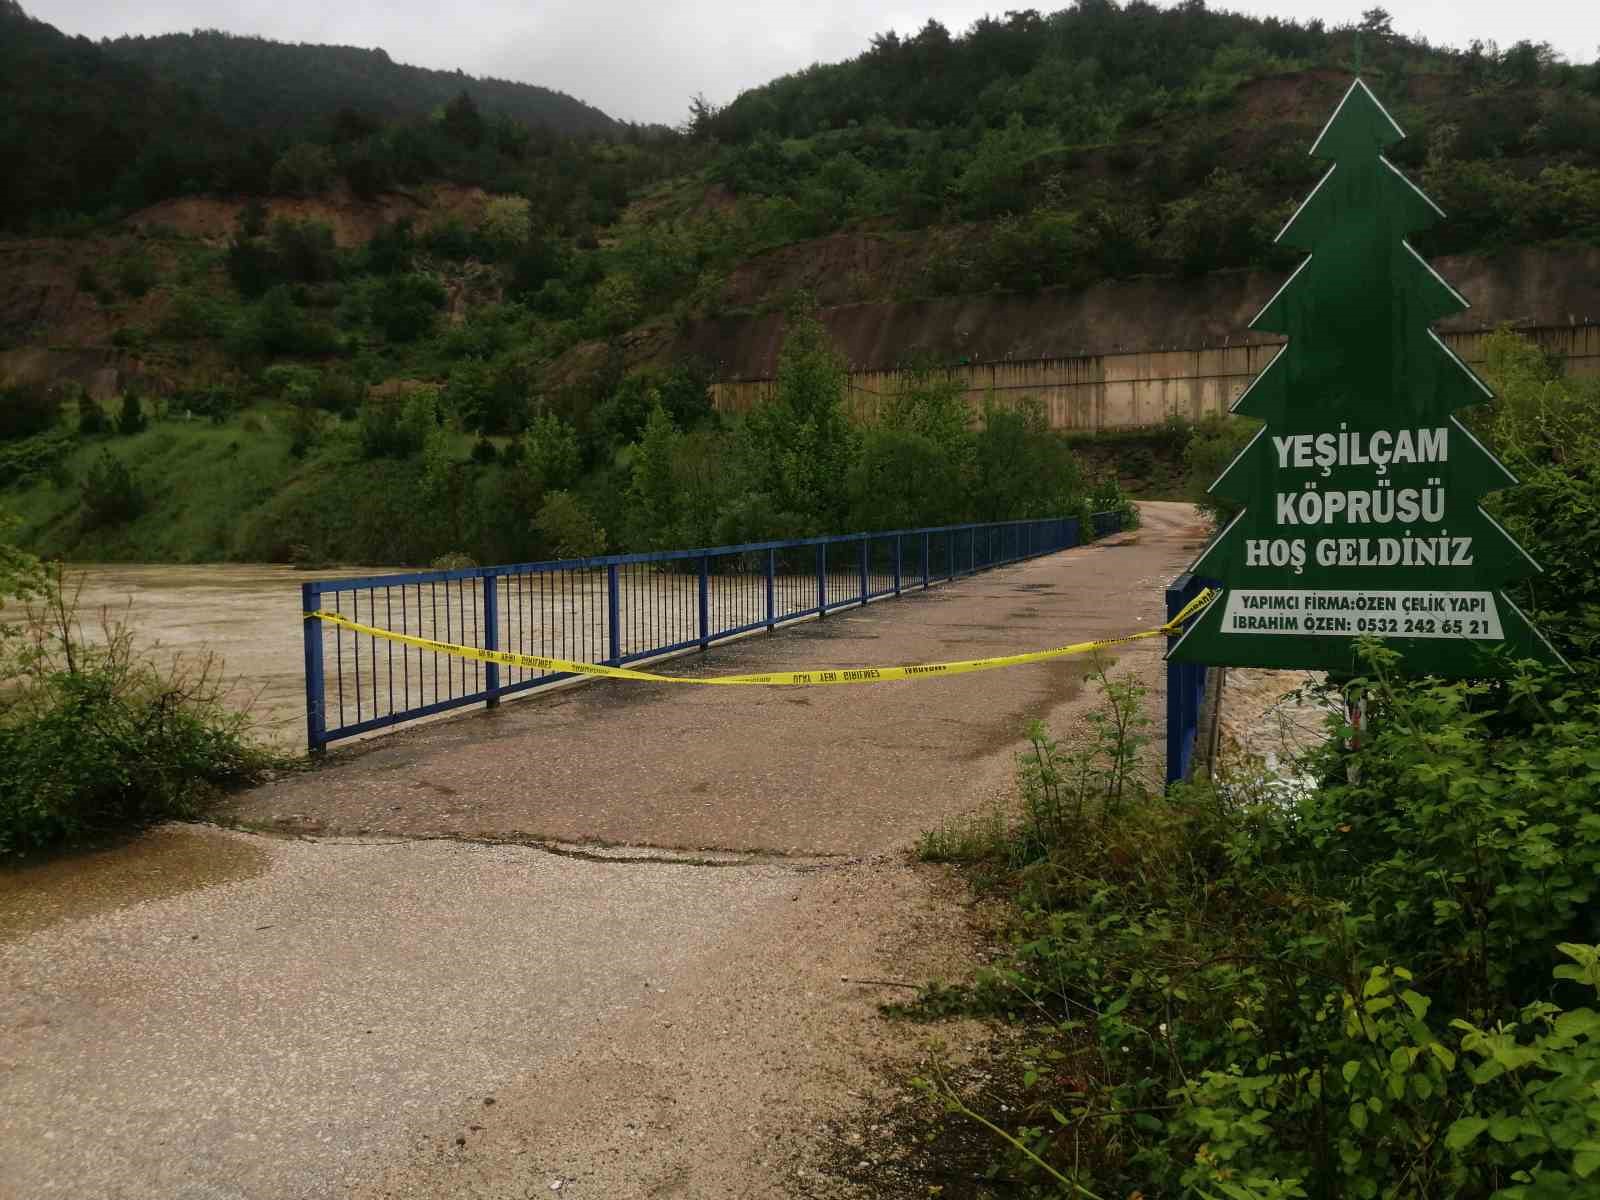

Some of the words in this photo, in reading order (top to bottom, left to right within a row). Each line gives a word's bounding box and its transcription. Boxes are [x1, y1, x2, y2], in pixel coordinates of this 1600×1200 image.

[1272, 422, 1448, 476] YEŞİLÇAM
[1276, 478, 1445, 525] KÖPRÜSÜ
[1246, 539, 1306, 574] HOŞ
[1315, 529, 1473, 566] GELDİNİZ
[1233, 612, 1298, 630] İBRAHİM
[1304, 613, 1351, 631] ÖZEN:
[1357, 616, 1398, 632] 0532
[1404, 618, 1435, 633] 242
[1441, 619, 1463, 634] 65
[1469, 620, 1489, 634] 21
[1241, 595, 1299, 610] YAPIMCI
[1402, 593, 1445, 615] ÇELİK
[1449, 597, 1486, 613] YAPI
